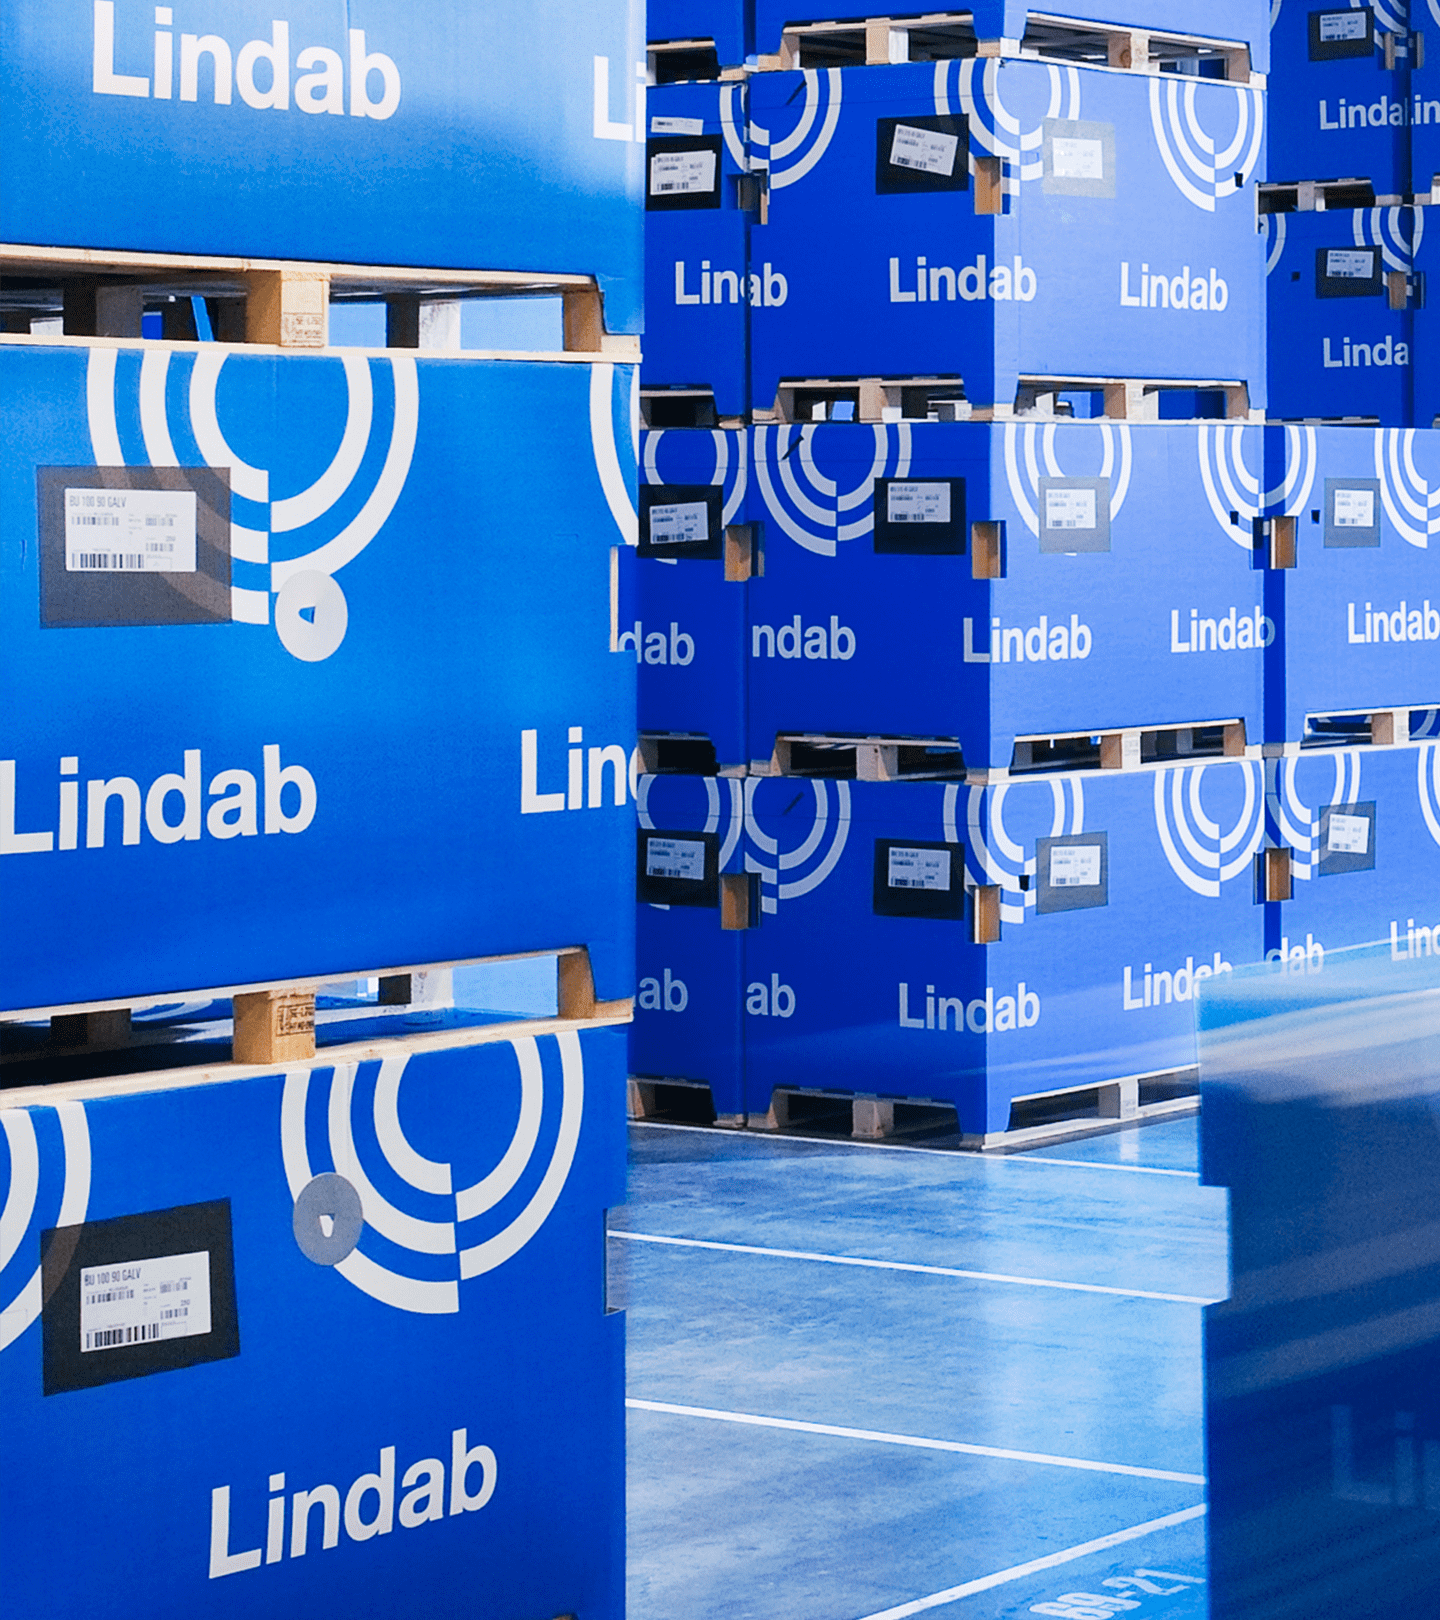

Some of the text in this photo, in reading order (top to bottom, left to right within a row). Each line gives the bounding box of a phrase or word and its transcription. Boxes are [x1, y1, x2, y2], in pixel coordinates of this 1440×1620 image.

[93, 0, 401, 120] Lindab
[1319, 95, 1408, 130] Linda
[889, 255, 1037, 303] Lindab
[1120, 261, 1229, 312] Lindab
[962, 615, 1092, 664] Lindab
[1171, 605, 1276, 653] Lindab
[1347, 600, 1440, 645] Lindab
[0, 743, 318, 855] Lindab
[899, 981, 1042, 1034] Lindab
[97, 1271, 110, 1285] 100
[209, 1427, 498, 1579] Lindab
